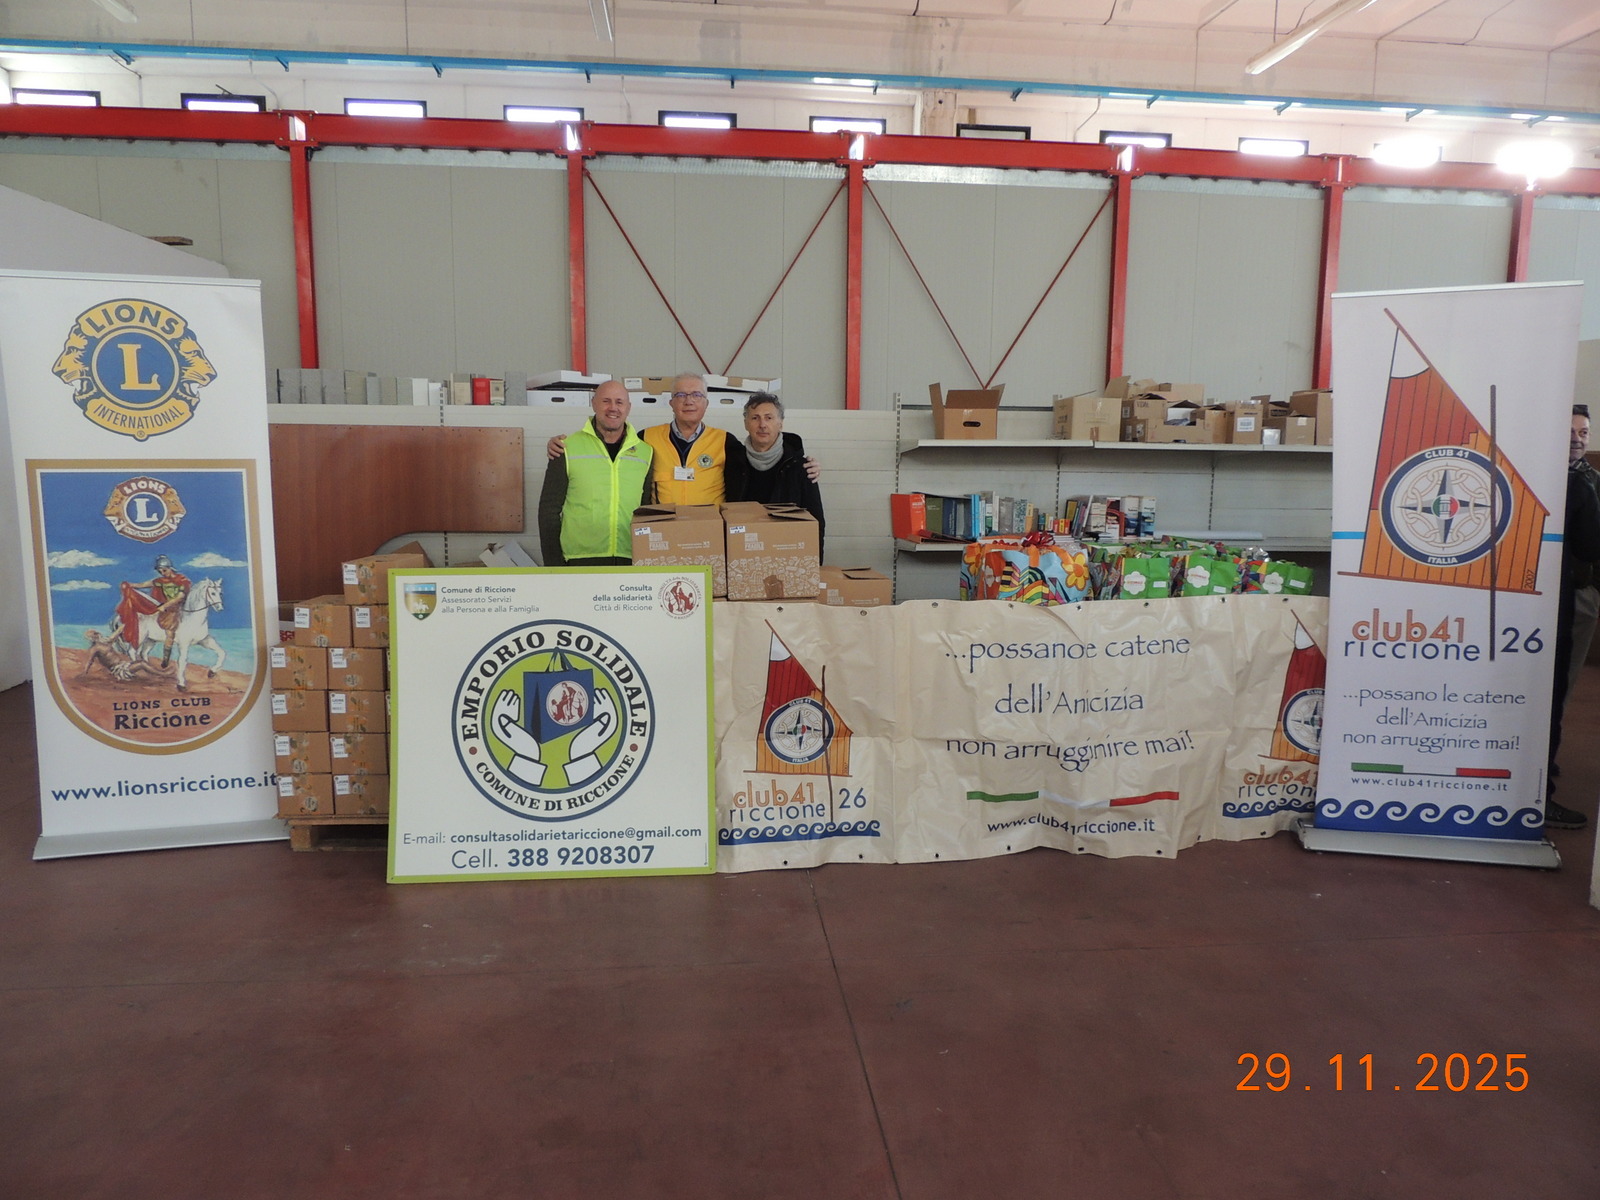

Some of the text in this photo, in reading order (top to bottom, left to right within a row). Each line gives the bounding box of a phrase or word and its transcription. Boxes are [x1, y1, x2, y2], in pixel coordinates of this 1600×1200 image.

[85, 304, 179, 336] LIONS
[117, 343, 161, 390] L
[93, 404, 184, 429] INTERNATIONAL
[1425, 449, 1470, 459] CLUB 41
[123, 480, 167, 494] LIONS
[133, 498, 159, 522] L
[1427, 556, 1458, 564] ITALIA
[1524, 569, 1535, 589] 2007
[509, 605, 539, 614] Famiglia
[1352, 608, 1465, 643] club41
[1105, 635, 1191, 657] catene
[1344, 641, 1481, 661] riccione
[1500, 626, 1544, 654] 26
[461, 630, 648, 741] EMPORIO SOLIDALE
[1344, 683, 1526, 707] ...possano le catene
[113, 697, 211, 711] LIONS CLUB
[114, 713, 212, 731] Riccione
[1376, 707, 1488, 729] dell'Amicizia
[946, 730, 1195, 772] non arrugginire mai!
[1343, 733, 1520, 753] non arrugginire mai!
[51, 771, 278, 801] www.lionsriccione.it
[476, 754, 635, 811] COMUNE DI RICCIONE
[1238, 784, 1317, 798] riccion
[1351, 776, 1508, 791] www.club41riccione.it
[732, 779, 815, 809] club41
[838, 787, 867, 809] 26
[729, 802, 826, 823] riccione
[987, 811, 1156, 836] www.club41riccione.it
[403, 826, 702, 845] E-mail: consultasolidarietariccione@gmail.com
[451, 844, 655, 869] Cell. 388 9208307
